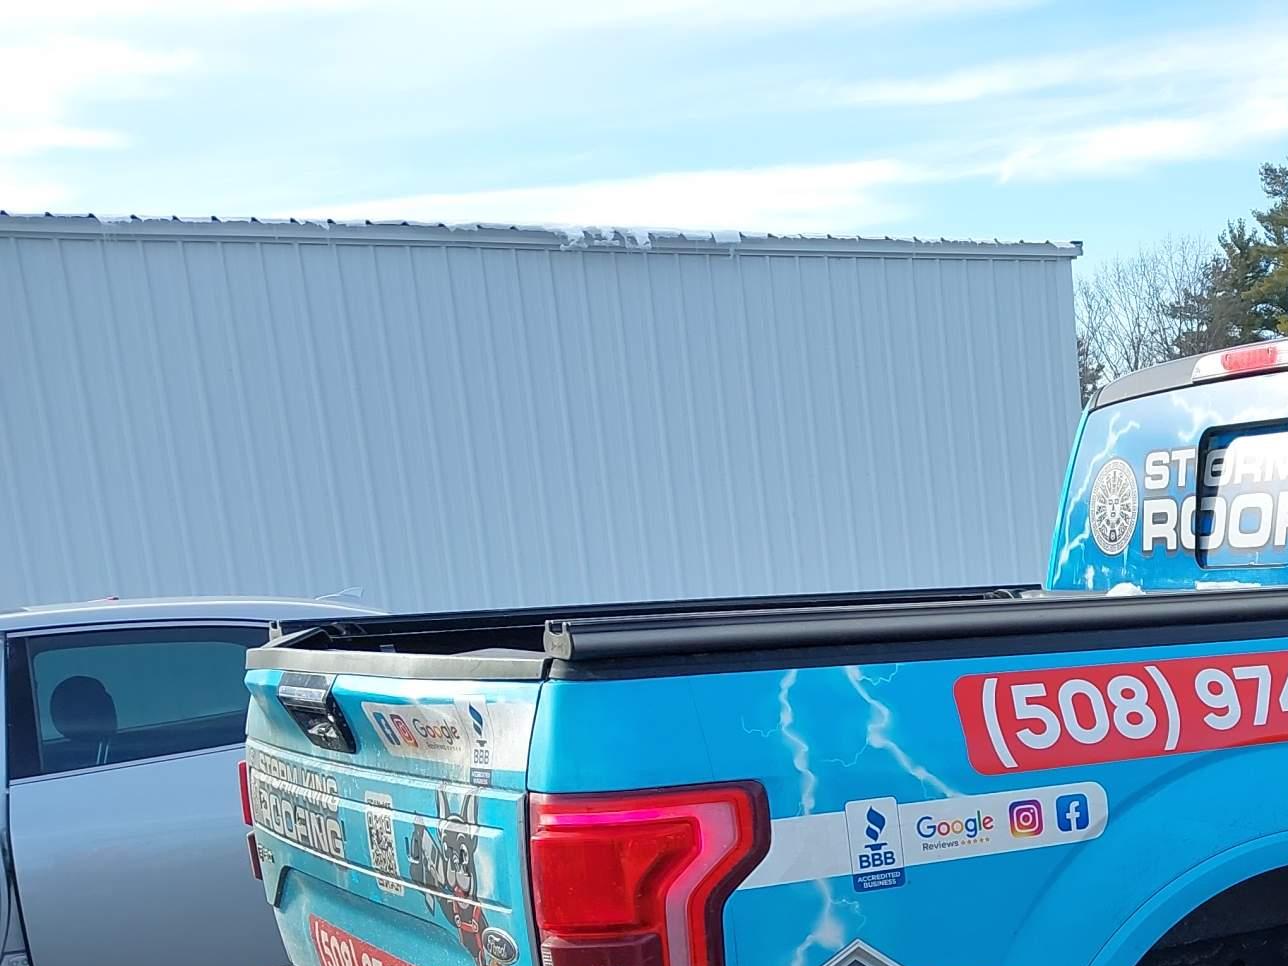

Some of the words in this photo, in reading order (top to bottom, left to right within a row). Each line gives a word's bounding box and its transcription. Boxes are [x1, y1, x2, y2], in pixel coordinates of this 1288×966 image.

[982, 664, 1182, 769] (508)
[411, 717, 461, 746] Google
[473, 748, 490, 765] BBB
[258, 753, 298, 799] STORM
[300, 767, 340, 812] KING
[916, 810, 994, 839] Google
[922, 838, 960, 852] Reviews
[858, 851, 897, 870] BBB
[857, 870, 902, 884] ACCREDITED
[863, 878, 897, 889] BUSINESS
